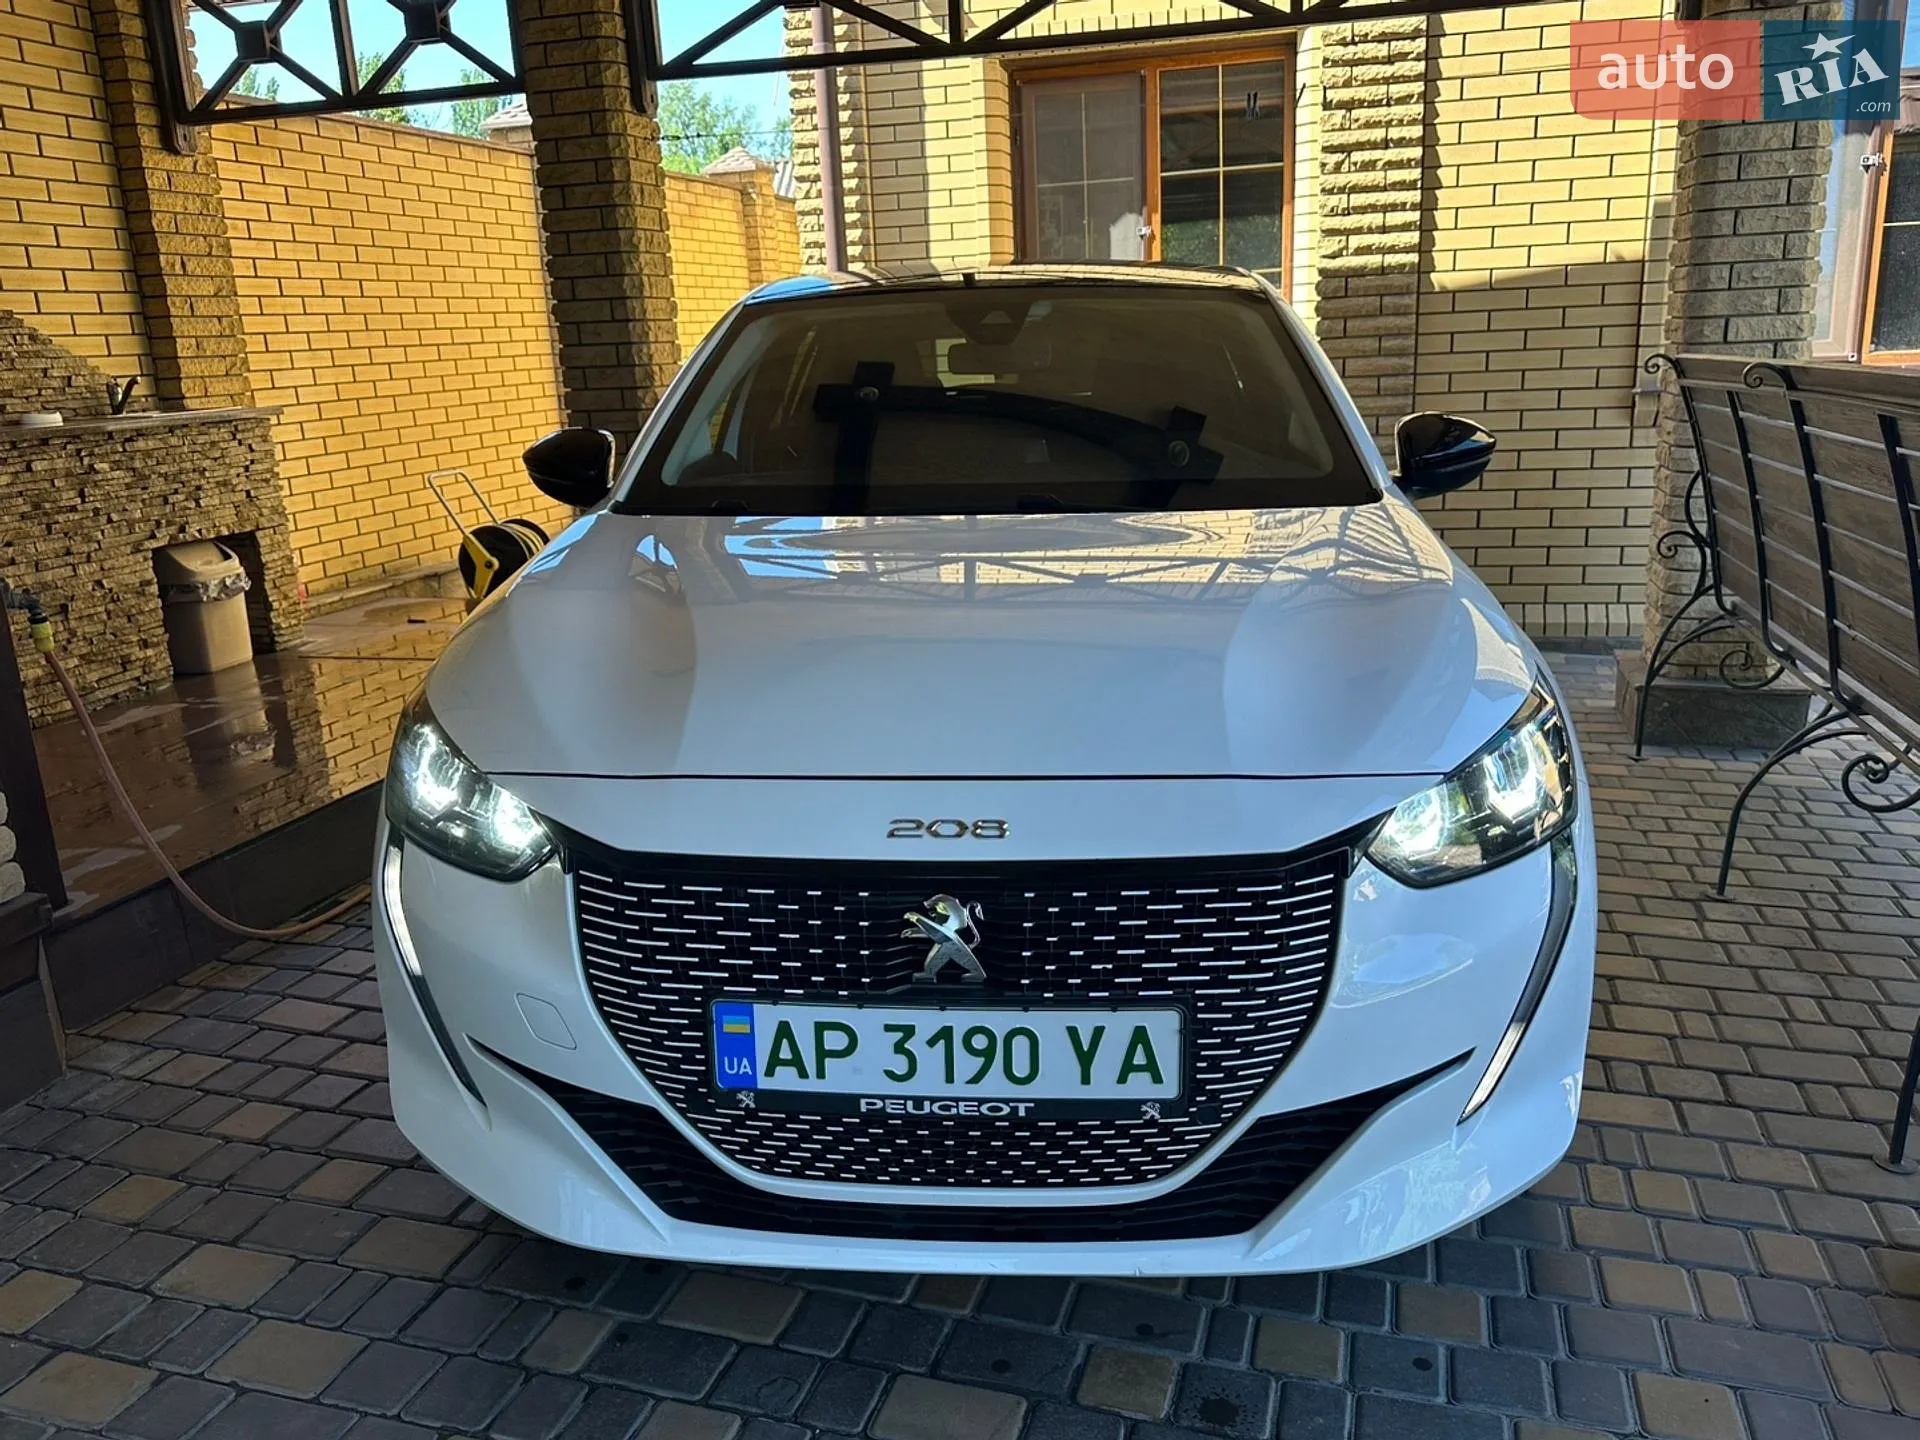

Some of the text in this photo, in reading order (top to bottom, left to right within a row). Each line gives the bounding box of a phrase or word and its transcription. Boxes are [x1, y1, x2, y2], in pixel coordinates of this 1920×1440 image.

[887, 818, 1009, 839] 208
[764, 1020, 1164, 1086] AP 3190 YA
[724, 1057, 752, 1075] UA
[860, 1099, 1034, 1117] PEUGEOT
